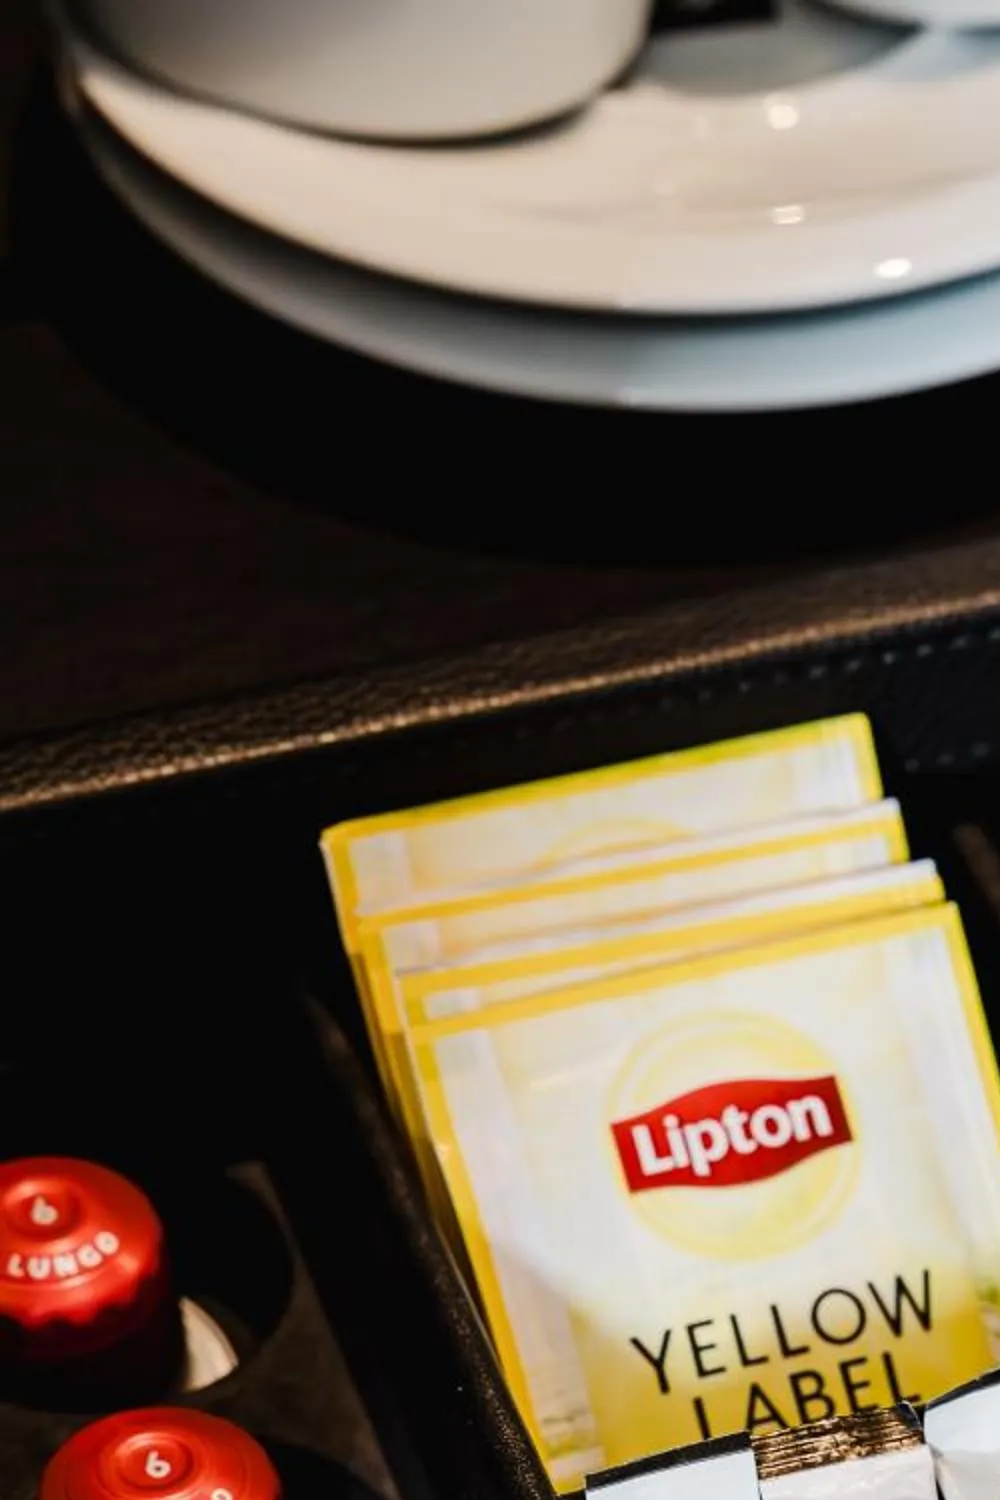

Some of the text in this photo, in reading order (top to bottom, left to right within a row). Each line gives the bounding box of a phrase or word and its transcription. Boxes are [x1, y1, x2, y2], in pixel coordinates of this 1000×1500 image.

[630, 1092, 834, 1178] Lipton
[31, 1197, 57, 1224] 6
[6, 1230, 120, 1281] LUNGO
[630, 1269, 934, 1395] YELLOW
[692, 1351, 922, 1440] LABEL
[145, 1450, 171, 1480] 6
